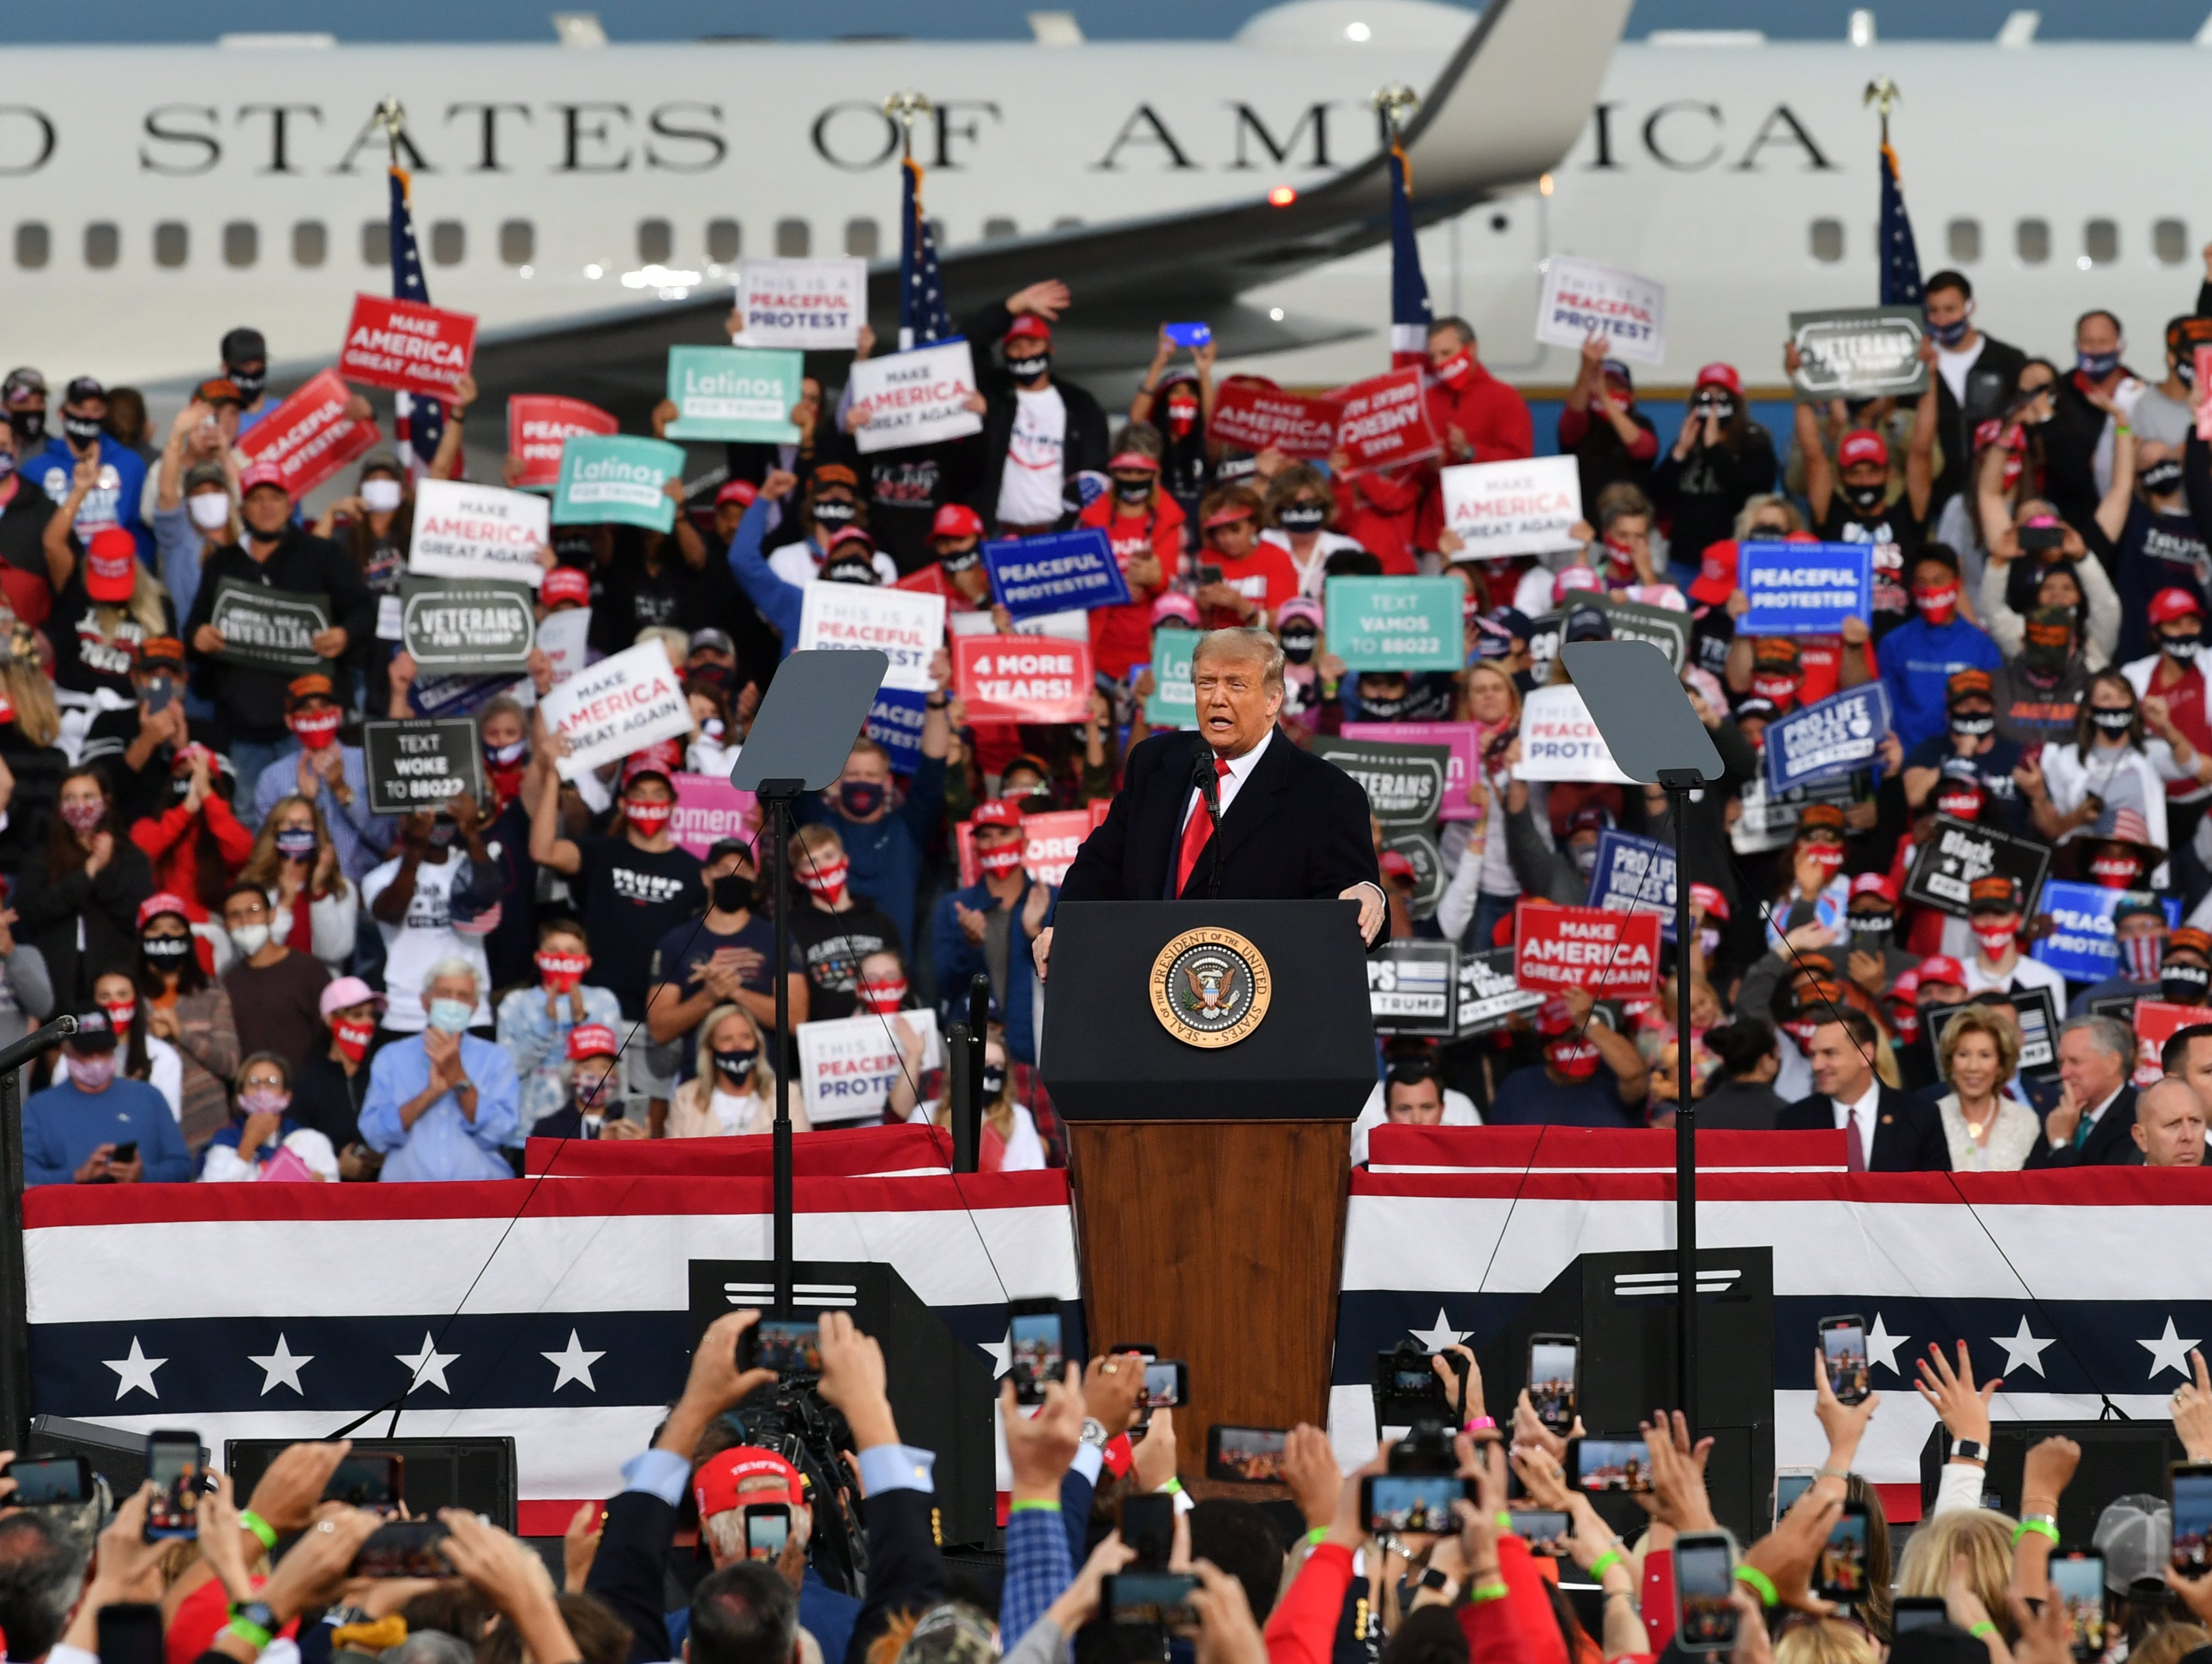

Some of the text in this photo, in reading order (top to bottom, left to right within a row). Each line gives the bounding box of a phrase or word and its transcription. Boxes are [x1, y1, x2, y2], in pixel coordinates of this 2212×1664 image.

[138, 101, 730, 176] STATES
[809, 100, 1002, 172] OF
[1084, 98, 1844, 172] AMICA
[750, 275, 797, 290] THIS
[749, 293, 850, 309] PEACEFUL
[1556, 291, 1652, 324] PEACEFUL
[388, 313, 440, 340] MAKE
[748, 310, 850, 327] PROTEST
[1553, 309, 1652, 341] PROTEST
[351, 327, 464, 367] AMERICA
[344, 350, 403, 374] GREAT
[885, 365, 931, 383] MAKE
[685, 369, 783, 397] Latinos
[859, 378, 969, 412] AMERICA
[572, 454, 662, 486] Latinos
[458, 499, 509, 517] MAKE
[1456, 493, 1572, 519] AMERICA
[421, 516, 537, 546] AMERICA
[419, 541, 477, 560] GREAT
[998, 553, 1104, 583] PEACEFUL
[1750, 568, 1859, 587] PEACEFUL
[1004, 572, 1110, 603] PROTESTER
[1750, 591, 1858, 608] PROTESTER
[1372, 594, 1417, 610] TEXT
[419, 608, 523, 634] VETERANS
[1359, 616, 1430, 632] VAMOS
[817, 622, 925, 647] PEACEFUL
[1352, 637, 1441, 654] TO 88022
[973, 654, 1074, 676] 4 MORE
[576, 669, 627, 700] MAKE
[977, 678, 1072, 702] YEARS!
[557, 678, 670, 732] AMERICA
[623, 700, 679, 734] AGAIN
[1530, 723, 1597, 738] PEACE
[398, 734, 441, 754] TEXT
[394, 756, 449, 776] WOKE
[385, 780, 407, 799] TO
[670, 806, 742, 831] omen
[1026, 835, 1076, 859] ORE
[1559, 921, 1617, 940] MAKE
[1522, 937, 1652, 966] AMERICA
[1521, 962, 1650, 985] GREAT AGAIN
[1154, 931, 1267, 1042] SEAL OF THE PRESIDENT OF THE UNITED STATES
[1380, 993, 1446, 1010] TRUMP
[817, 1053, 897, 1077] PEACEF
[819, 1075, 899, 1099] PROTE
